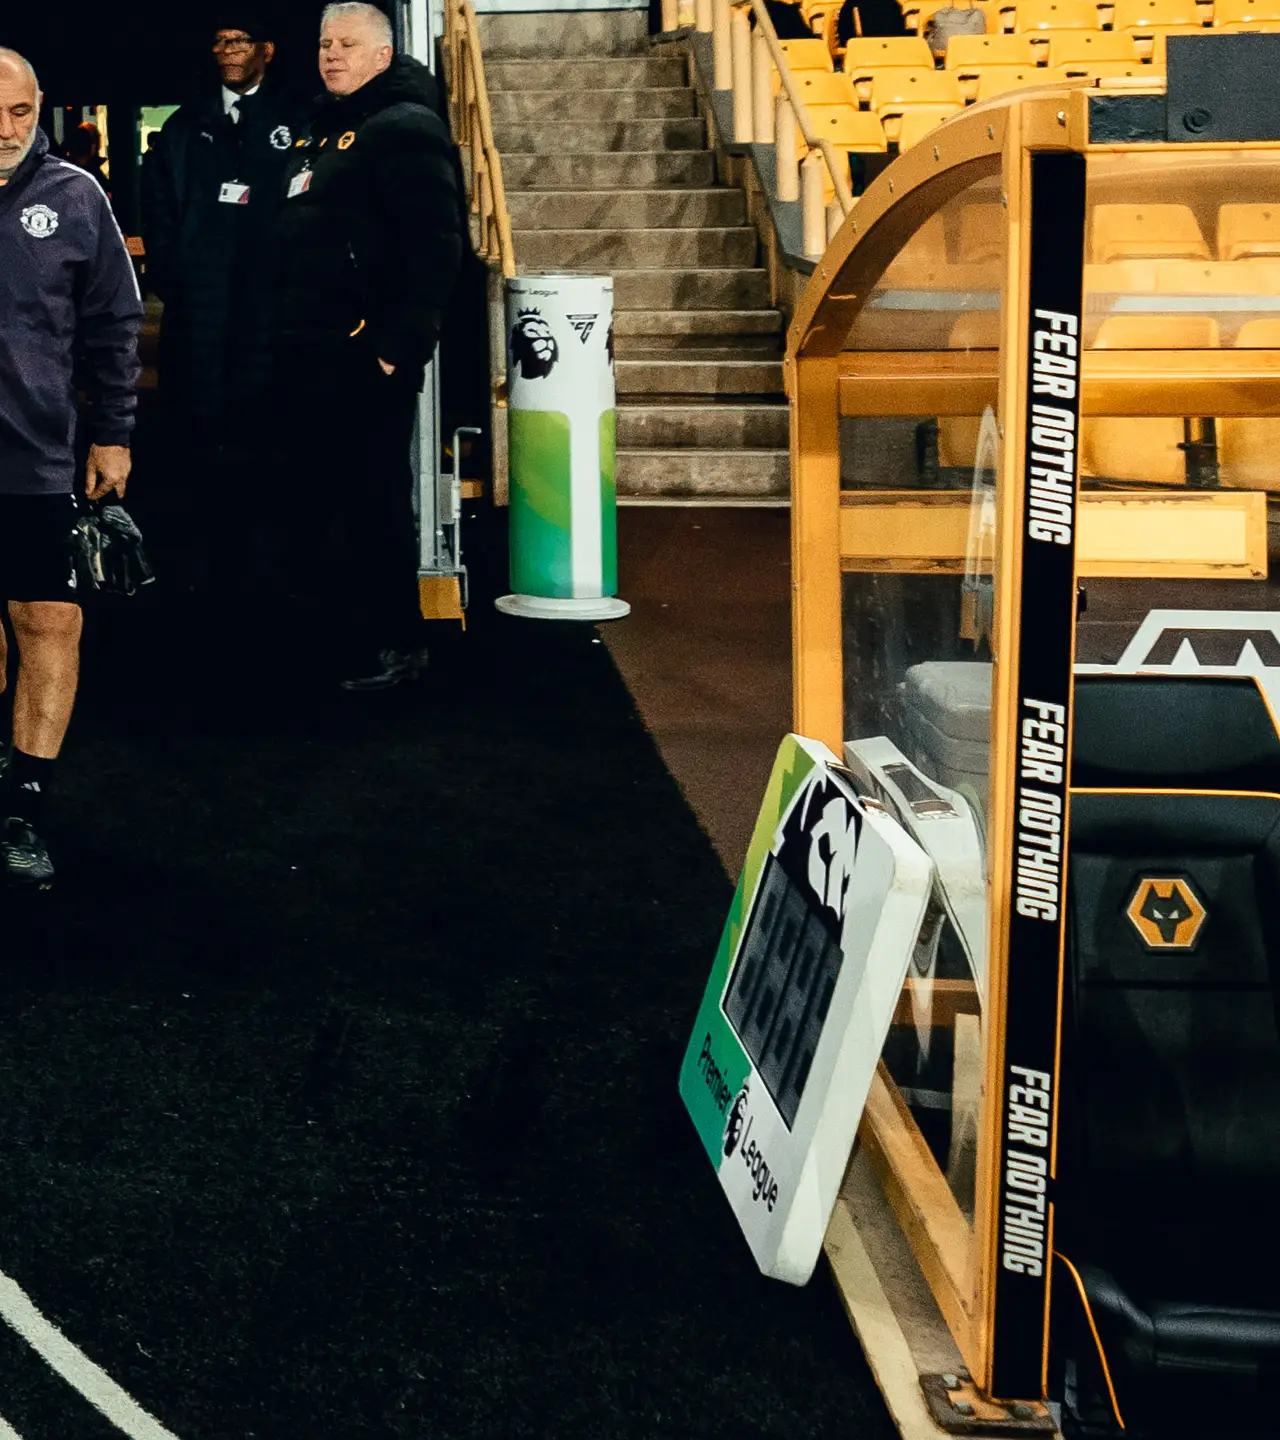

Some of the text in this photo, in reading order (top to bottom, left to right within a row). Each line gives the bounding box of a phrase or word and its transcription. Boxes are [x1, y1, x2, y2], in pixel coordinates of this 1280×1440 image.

[1028, 308, 1079, 547] FEAR NOTHING
[1016, 697, 1066, 922] FEAR NOTHING
[697, 1031, 778, 1213] Premier League
[1002, 1064, 1052, 1278] FEAR NOTHING
